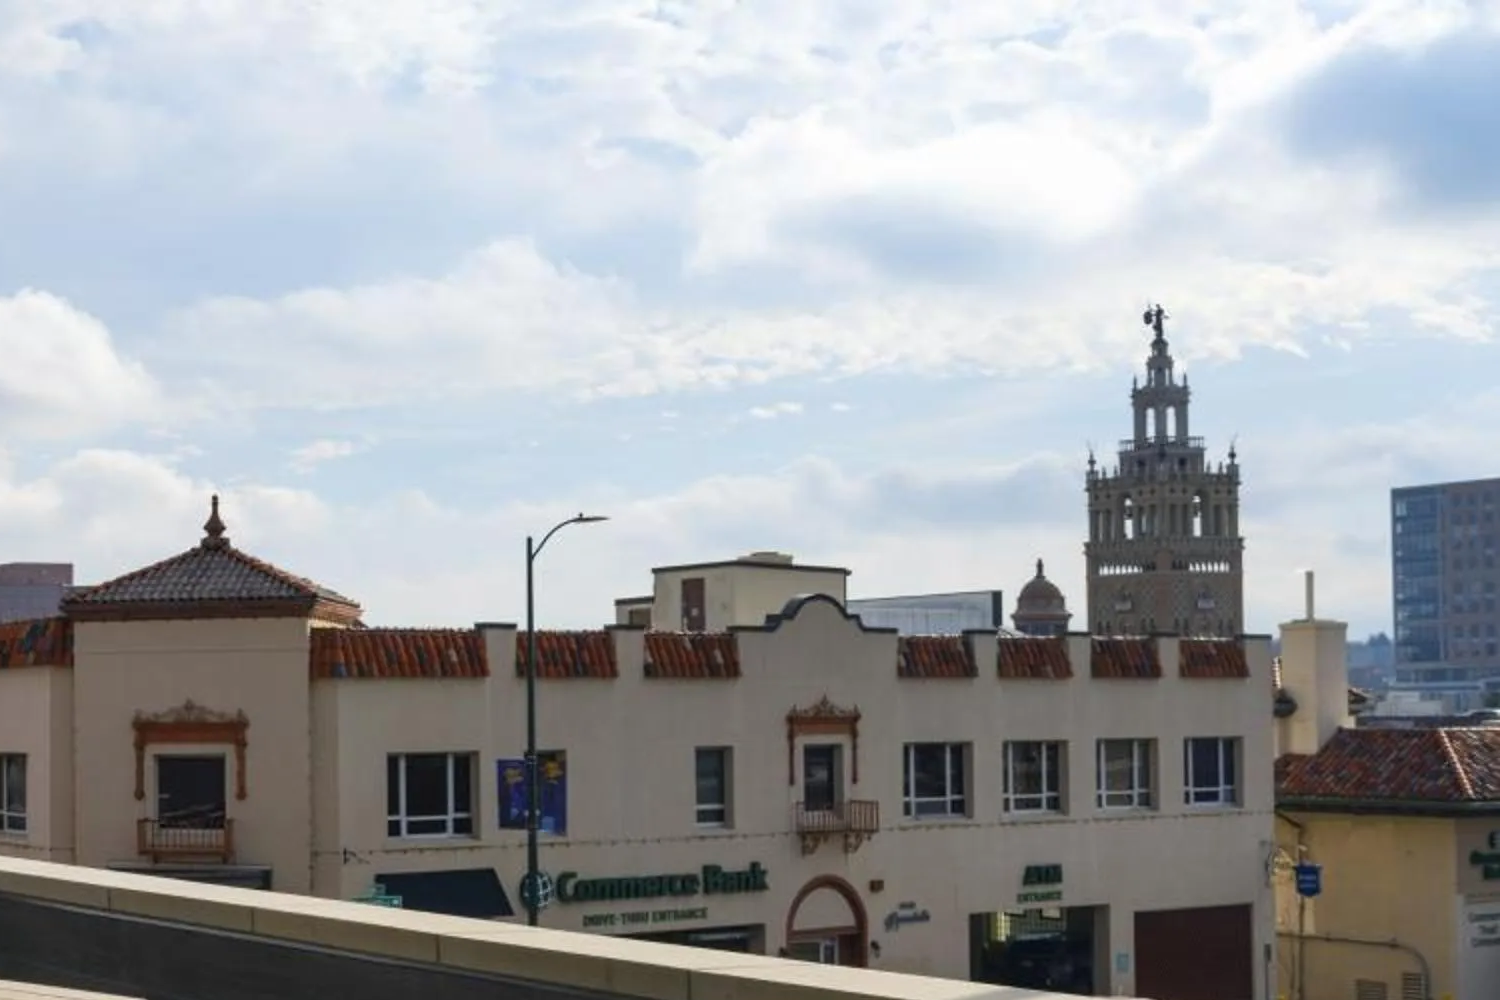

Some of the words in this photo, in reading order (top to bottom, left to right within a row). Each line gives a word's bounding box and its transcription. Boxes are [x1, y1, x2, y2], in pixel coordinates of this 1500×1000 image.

[557, 871, 699, 904] Commerce
[703, 861, 769, 895] Bank
[1023, 865, 1062, 886] ATM
